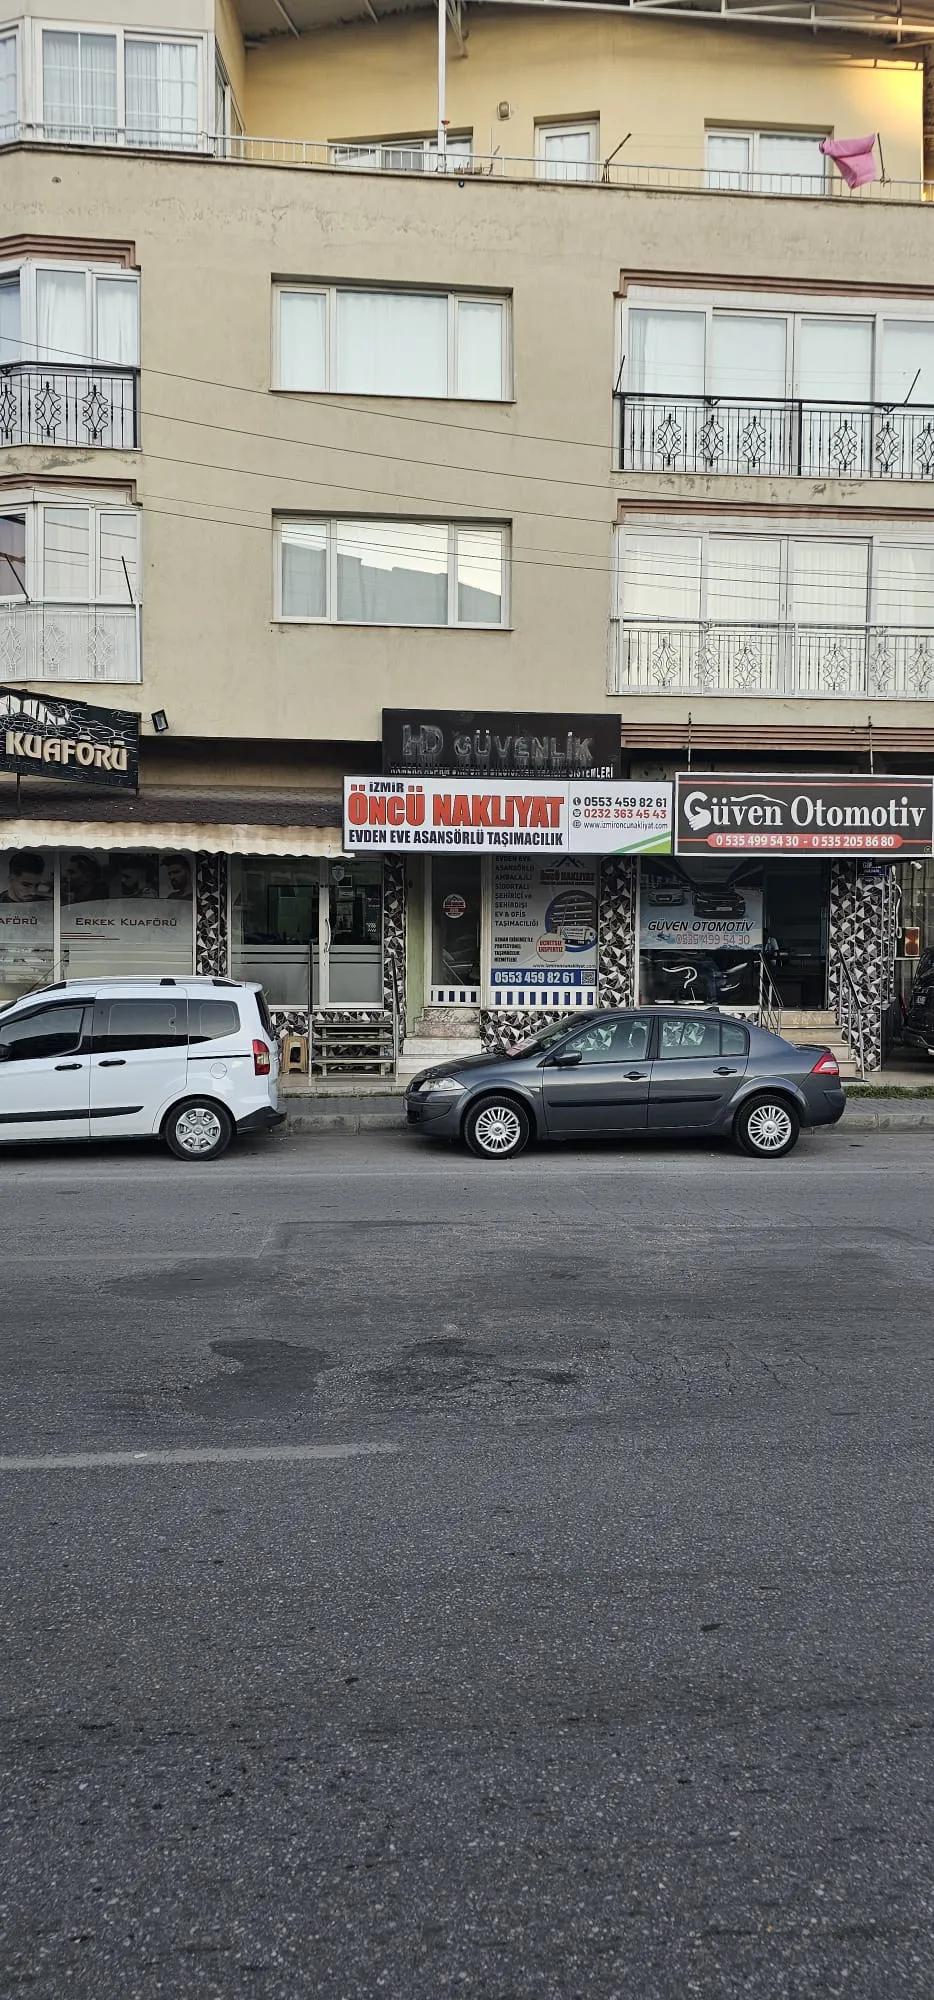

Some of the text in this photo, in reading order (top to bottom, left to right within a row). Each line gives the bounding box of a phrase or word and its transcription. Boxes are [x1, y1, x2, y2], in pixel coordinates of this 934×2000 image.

[402, 724, 444, 756] HD
[5, 731, 128, 771] KUAFÖRÜ
[348, 784, 565, 828] ÖNCÜ NAKLİYAT
[584, 796, 667, 808] 0553 459 82 61
[584, 808, 667, 819] 0232 363 45 43
[683, 791, 927, 831] Güven Otomotiv
[349, 829, 564, 848] EVDEN EVE ASANSÖRLÜ TAŞIMACILIK
[715, 835, 723, 846] 0
[725, 835, 745, 846] 535
[747, 835, 768, 846] 499
[770, 836, 783, 846] 54
[785, 836, 799, 847] 30
[811, 836, 818, 847] 0
[821, 836, 841, 847] 535
[843, 836, 864, 847] 205
[865, 836, 879, 847] 86
[880, 836, 894, 847] 80
[648, 917, 754, 931] GÜVEN OTOMOTİV
[702, 934, 720, 945] 499
[723, 934, 736, 944] 54
[738, 934, 750, 945] 30
[494, 971, 575, 984] 0553 459 82 61
